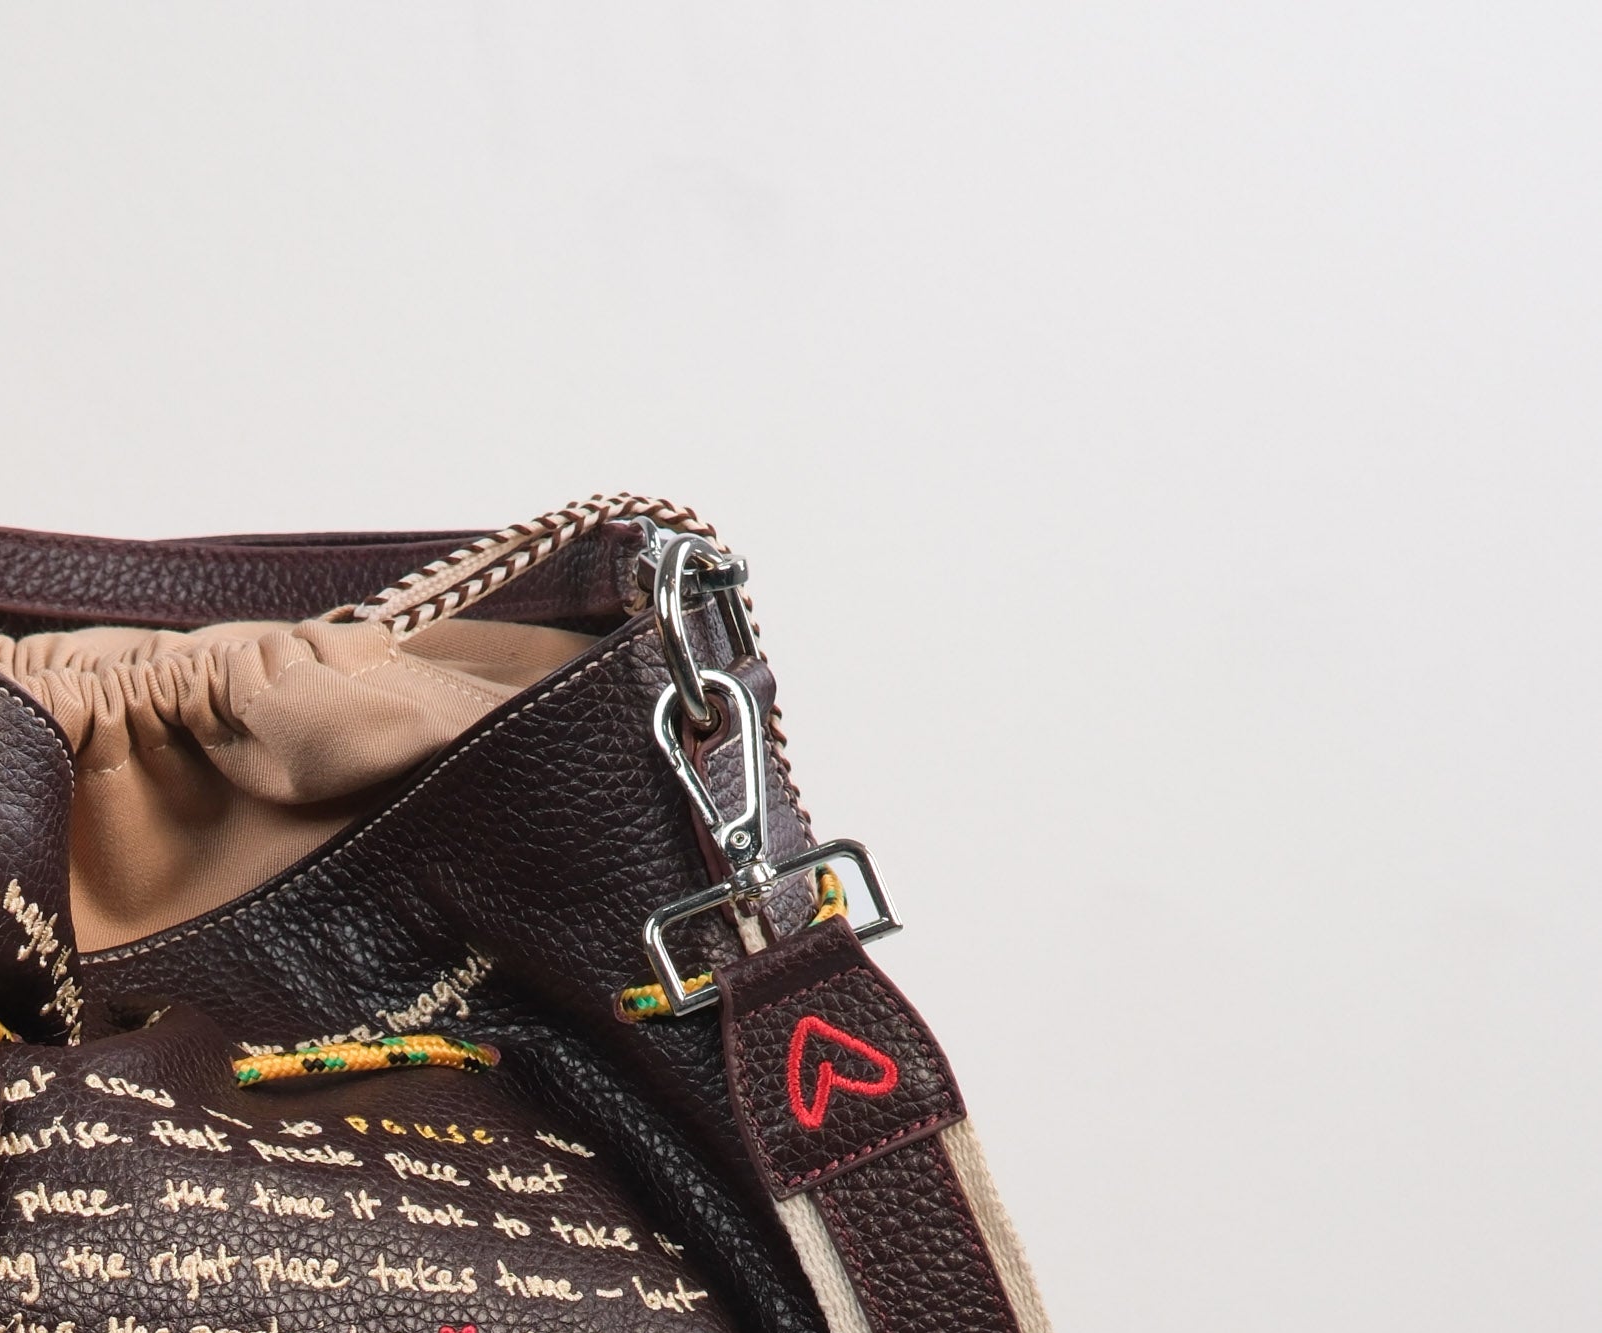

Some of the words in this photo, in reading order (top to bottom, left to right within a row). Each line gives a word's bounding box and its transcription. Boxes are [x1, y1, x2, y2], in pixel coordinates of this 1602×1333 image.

[159, 1180, 229, 1212] the
[345, 1190, 381, 1220] it
[398, 1195, 478, 1228] took
[494, 1212, 531, 1239] to
[551, 1217, 639, 1251] take
[60, 1246, 131, 1282] the
[150, 1244, 240, 1301] right
[253, 1248, 350, 1292] place
[369, 1254, 478, 1293] takes
[632, 1276, 708, 1314] but
